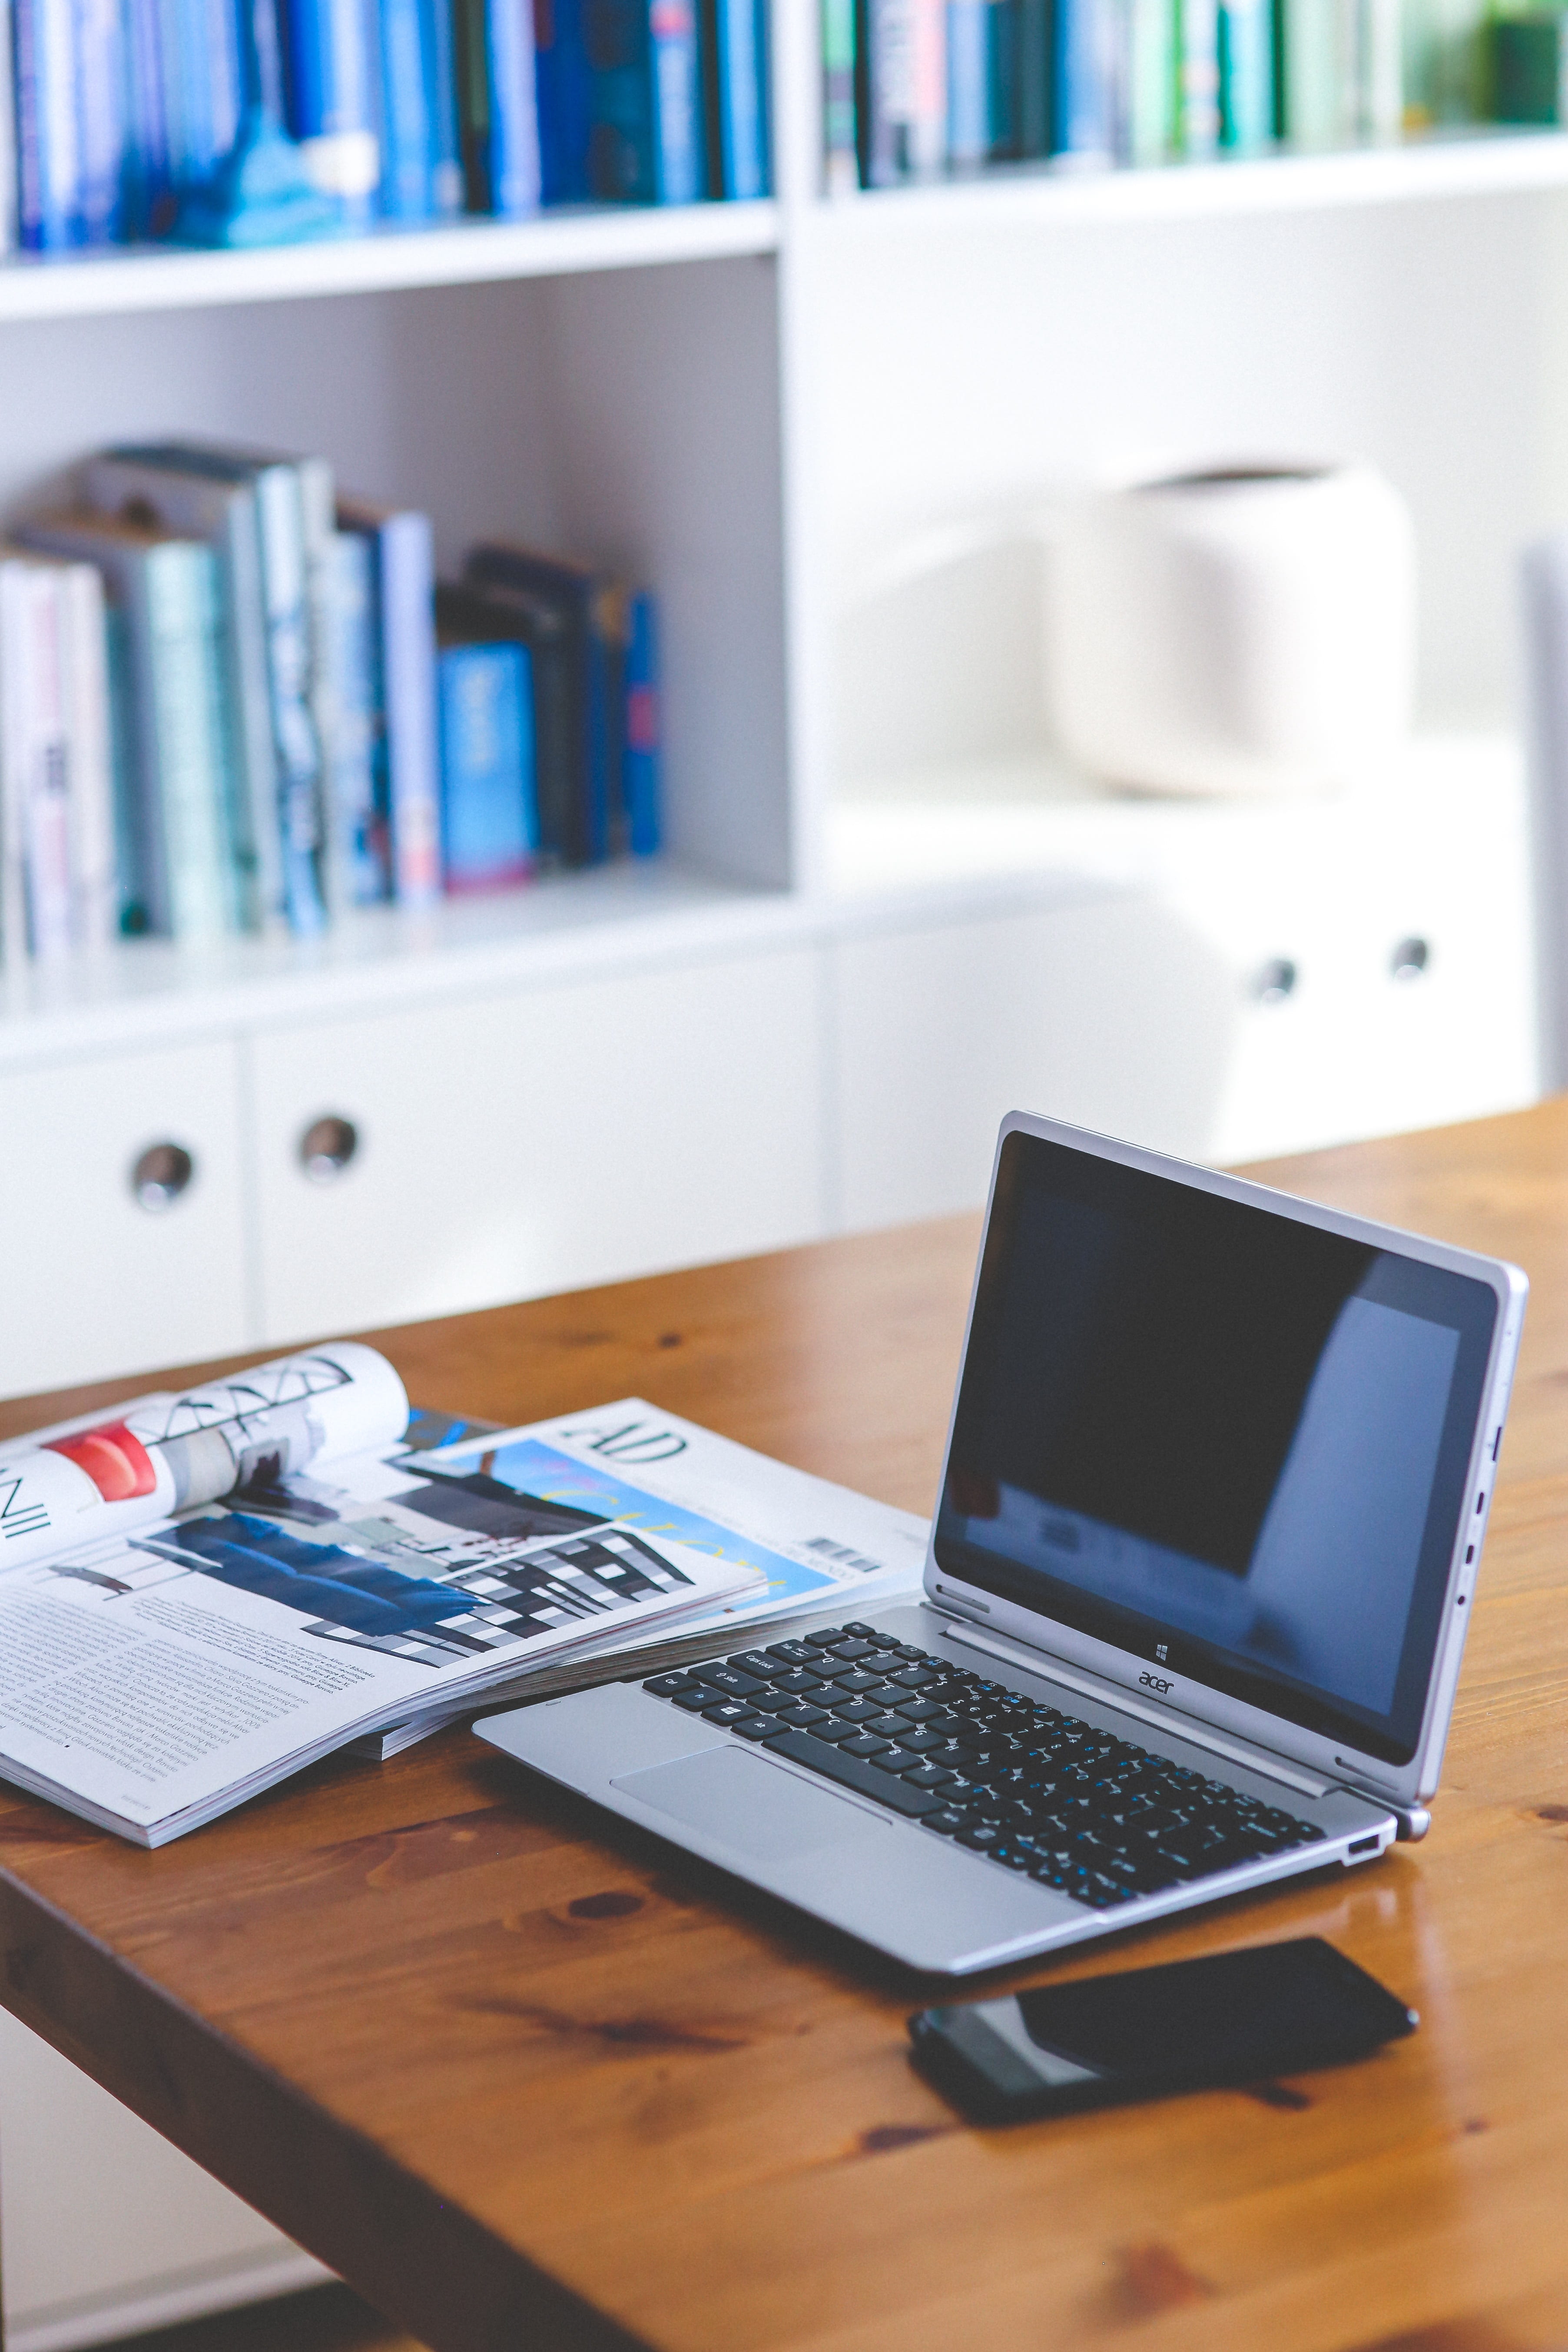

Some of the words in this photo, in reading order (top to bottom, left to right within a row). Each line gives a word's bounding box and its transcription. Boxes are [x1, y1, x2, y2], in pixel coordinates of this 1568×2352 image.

[559, 1421, 688, 1463] AD
[315, 1665, 338, 1675] Giuseppe
[746, 1655, 761, 1663] Caps
[758, 1661, 774, 1669] Lock
[212, 1678, 231, 1688] Marco
[231, 1686, 259, 1700] Gazziero
[242, 1682, 269, 1695] Gazziero
[291, 1674, 315, 1686] Giuseppe
[318, 1679, 343, 1691] Giuseppe
[1139, 1671, 1174, 1694] acer
[129, 1685, 168, 1705] komponentów
[193, 1716, 218, 1728] odbywa
[133, 1679, 160, 1692] Oznacza
[186, 1704, 216, 1718] produkcja
[181, 1692, 198, 1700] marki
[211, 1705, 239, 1718] certyfikat
[206, 1693, 239, 1710] kluczowymi
[233, 1696, 260, 1710] Rodzinne
[19, 1722, 47, 1736] systemem
[68, 1696, 86, 1705] strony
[85, 1705, 111, 1717] zarówno
[149, 1733, 169, 1745] Marco
[170, 1744, 198, 1761] Gazziero
[90, 1695, 127, 1716] kontynuującą
[127, 1714, 154, 1728] najlepsze
[154, 1726, 183, 1742] toskańskie
[108, 1687, 136, 1701] powstają
[155, 1708, 185, 1722] surowców
[183, 1722, 230, 1744] pochodzących
[136, 1709, 169, 1724] pochwalić
[167, 1723, 204, 1743] ekskluzywną
[19, 1711, 51, 1728] współpracy
[56, 1728, 71, 1739] firmą
[71, 1736, 90, 1747] Glauk
[87, 1746, 116, 1761] powstało
[40, 1713, 88, 1736] poszukiwaniach
[86, 1735, 111, 1747] nowych
[142, 1762, 167, 1777] Ostatnio
[60, 1711, 82, 1723] mógłby
[81, 1722, 117, 1739] zawojować
[116, 1738, 134, 1748] włoski
[155, 1758, 177, 1771] Bavuso
[87, 1714, 115, 1729] Gazziero
[115, 1728, 142, 1742] rozgląda
[161, 1750, 188, 1766] kolejnymi
